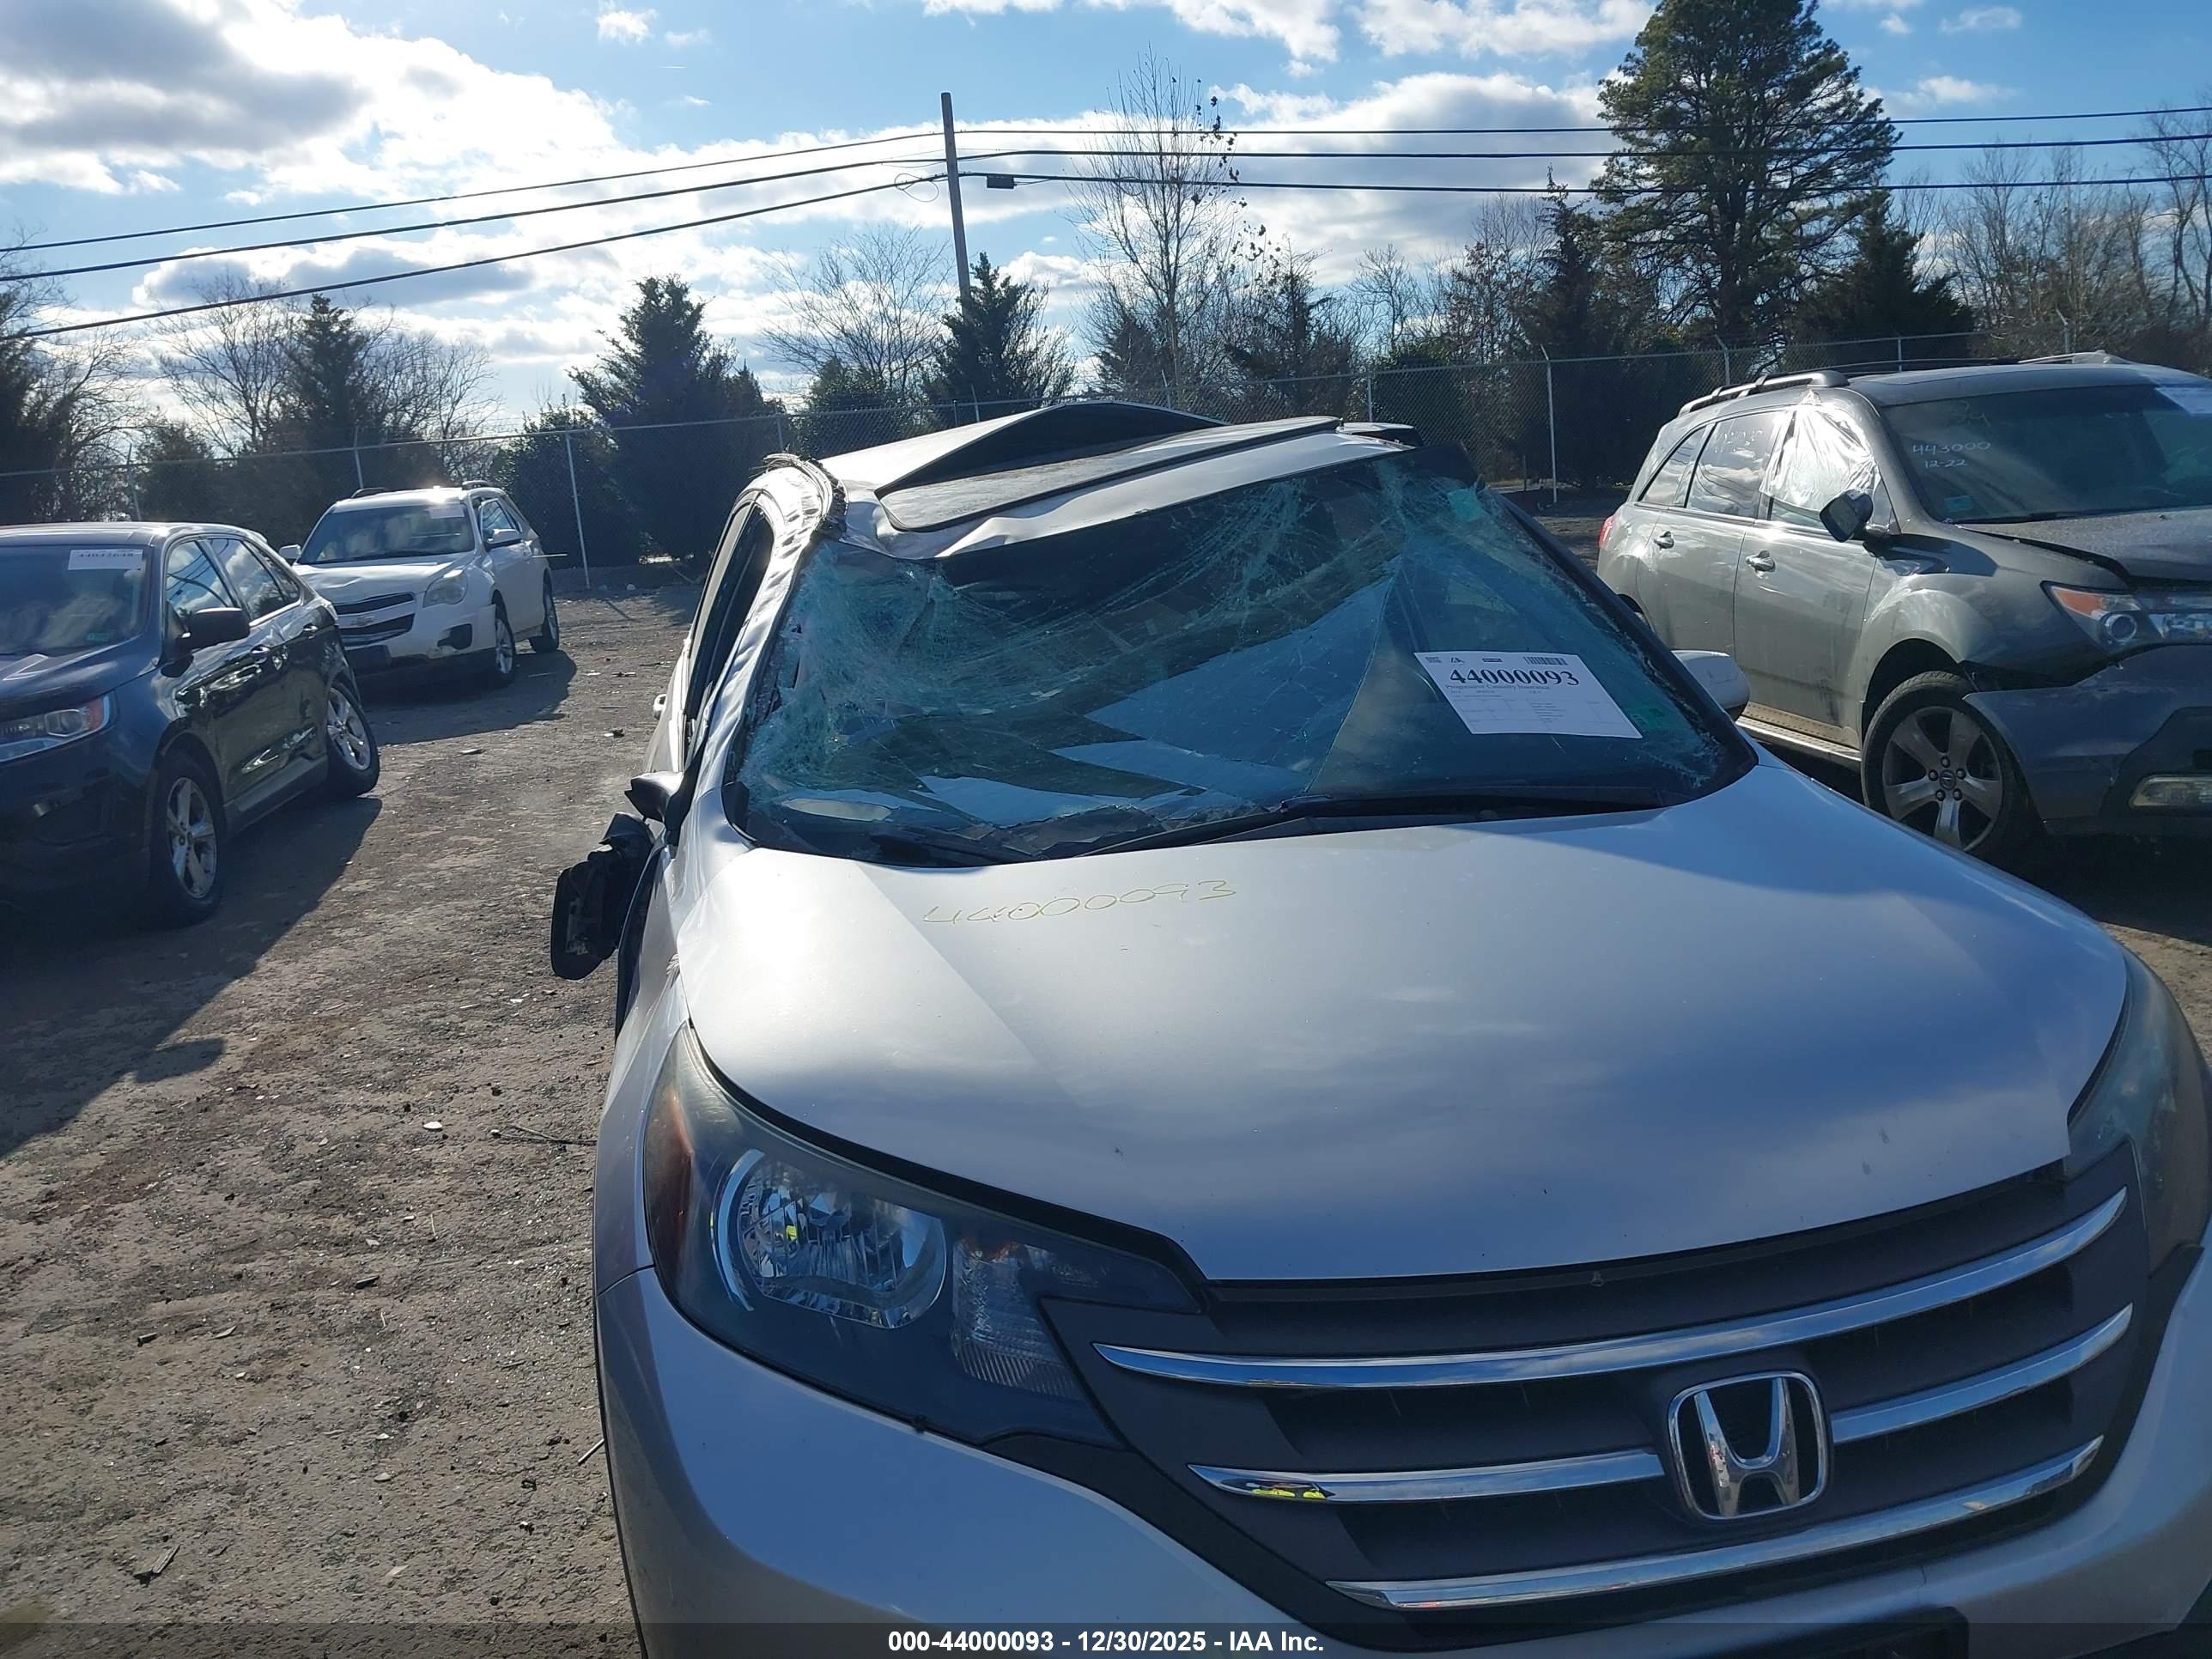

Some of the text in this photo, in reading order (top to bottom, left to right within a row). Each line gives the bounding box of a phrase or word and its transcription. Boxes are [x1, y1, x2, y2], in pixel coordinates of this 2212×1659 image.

[1911, 441, 1992, 456] 443000
[1923, 459, 1968, 469] 12-22
[1449, 668, 1580, 687] 44000093
